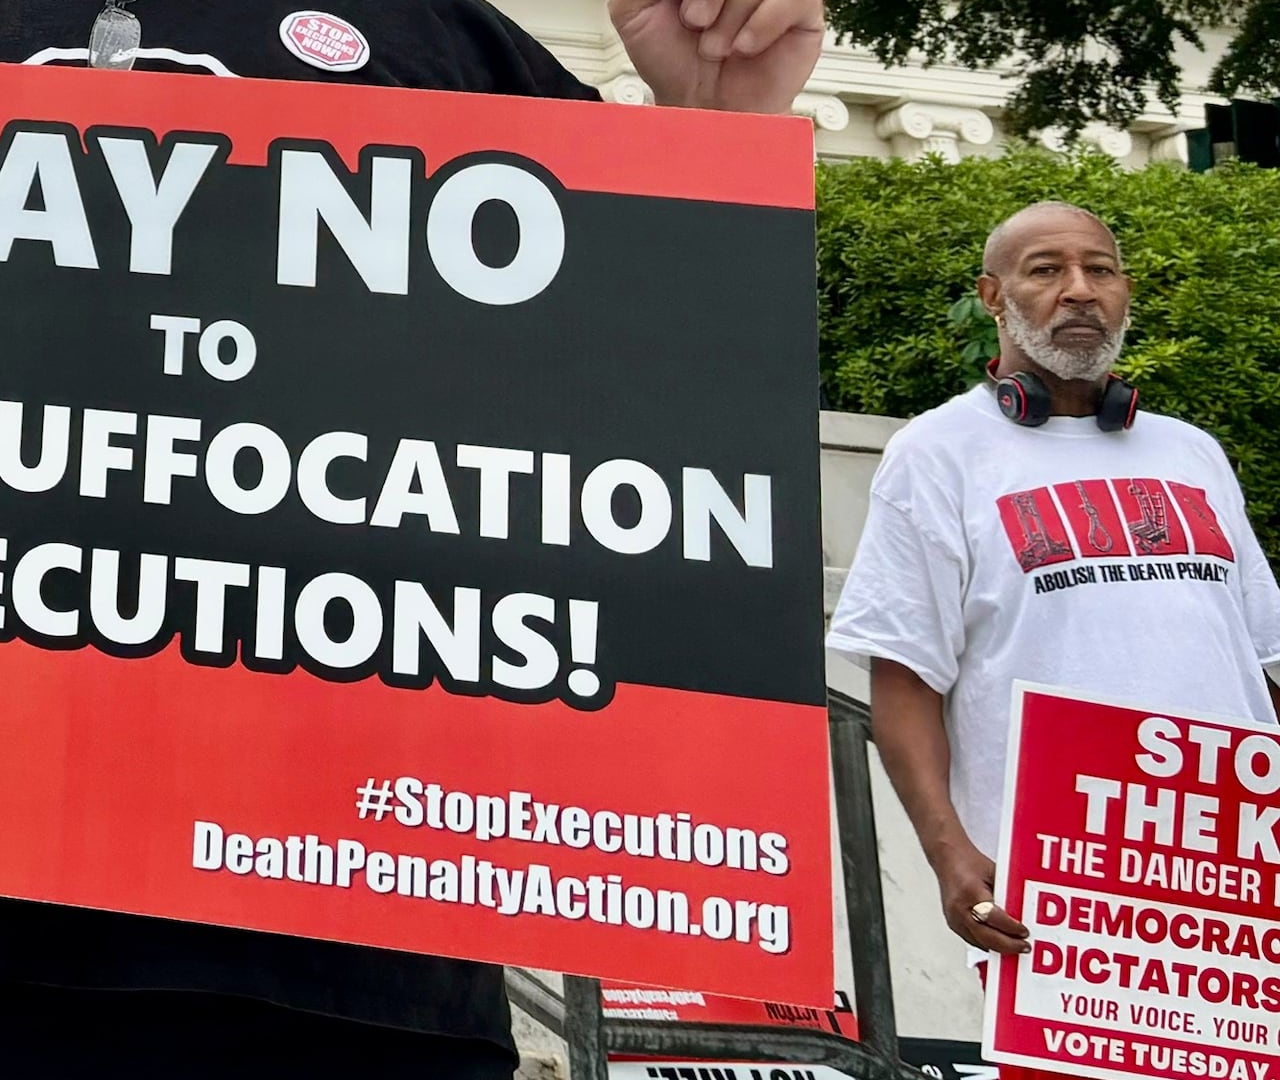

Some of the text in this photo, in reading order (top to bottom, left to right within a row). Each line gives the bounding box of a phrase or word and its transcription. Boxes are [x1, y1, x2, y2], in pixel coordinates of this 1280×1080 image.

[302, 38, 341, 59] NOW!
[307, 19, 354, 43] STOP
[277, 149, 565, 305] NO
[150, 314, 257, 382] TO
[1034, 566, 1097, 594] ABOLISH
[1098, 564, 1127, 583] THE
[1127, 562, 1176, 581] DEATH
[1134, 716, 1280, 795] STO
[355, 775, 790, 876] #StopExecutions
[1075, 773, 1280, 864] THE K
[192, 821, 791, 955] DeathPenaltyAction.org
[1036, 833, 1107, 878] THE
[1119, 847, 1262, 904] DANGER
[1031, 940, 1280, 1013] DICTATORS
[1042, 1027, 1125, 1063] VOTE
[1060, 992, 1119, 1022] YOUR
[1130, 1004, 1202, 1035] VOICE.
[1213, 1017, 1268, 1046] YOUR
